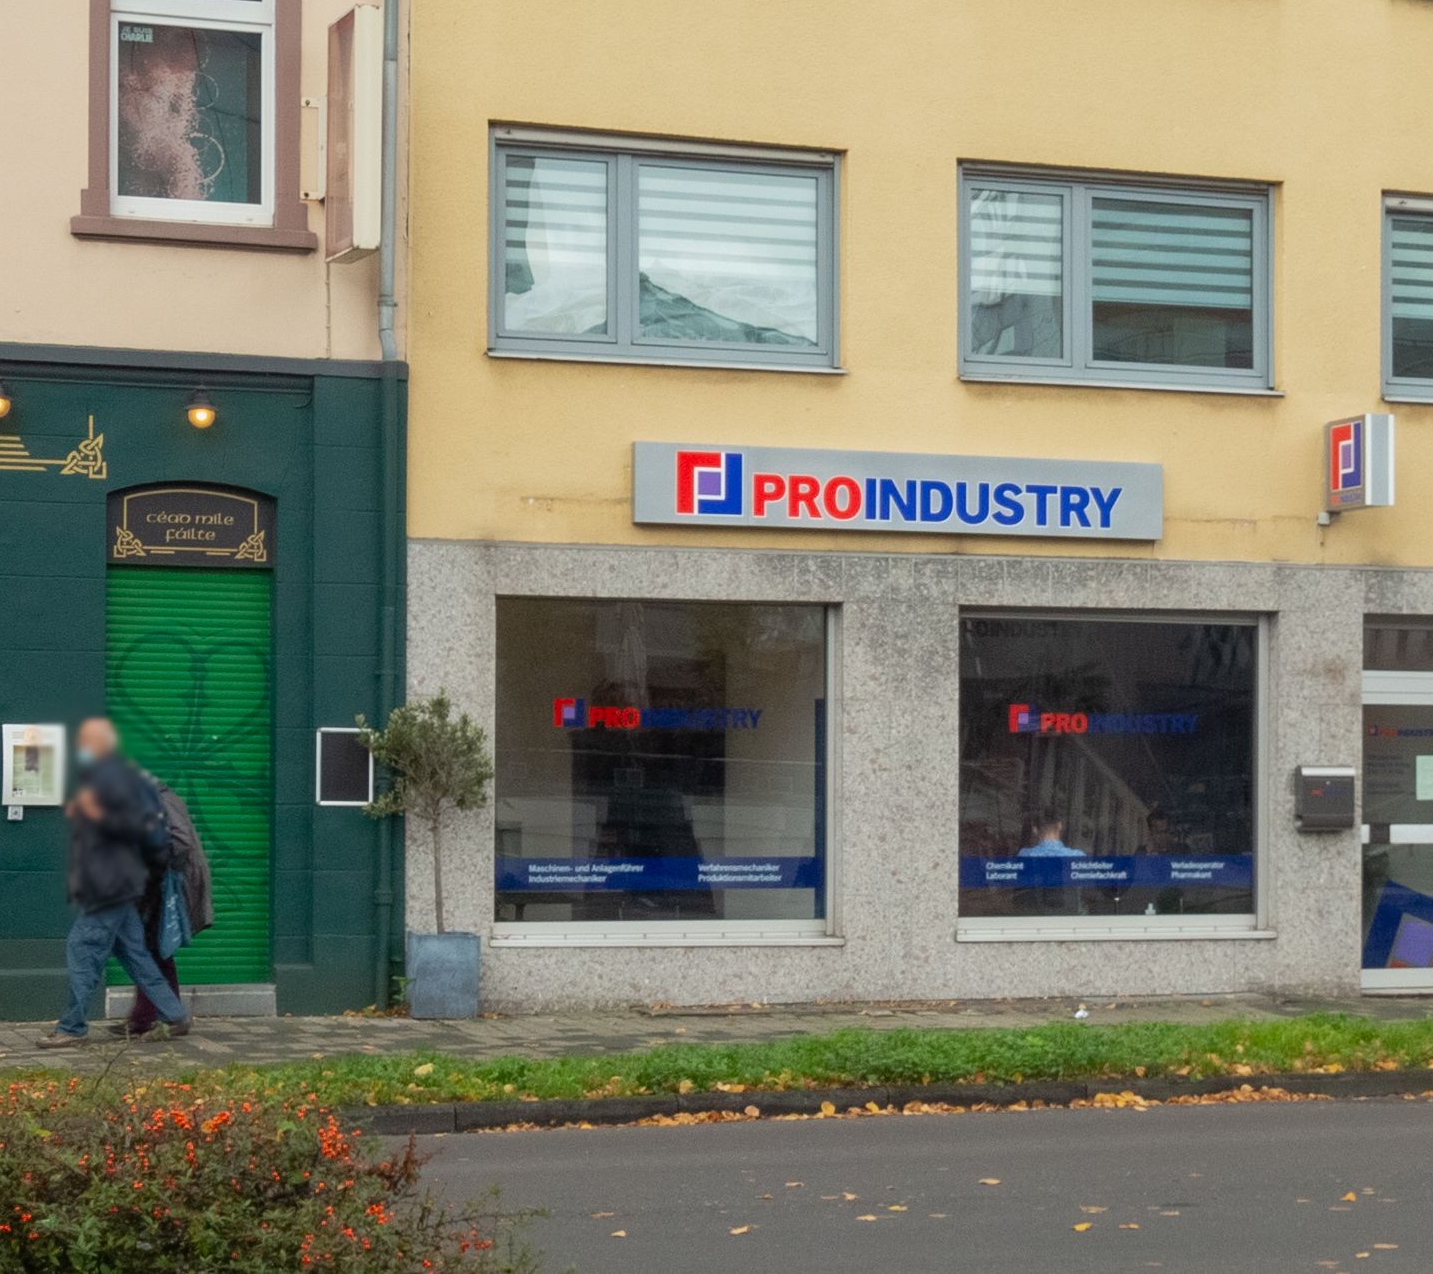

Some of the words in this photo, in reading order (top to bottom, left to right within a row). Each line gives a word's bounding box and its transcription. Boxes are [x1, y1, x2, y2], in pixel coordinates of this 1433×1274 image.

[752, 473, 1123, 529] PROINDUSTRY
[528, 863, 573, 872] Maschinen-
[575, 863, 590, 872] und
[591, 863, 645, 874] Anlagenführer
[698, 863, 780, 872] Verfahrensmechaniker
[986, 861, 1024, 870] Chemikant
[528, 874, 607, 883] Industriemechaniker
[697, 874, 782, 883] Produktionsmitarbeiter
[986, 871, 1018, 880] Laborant
